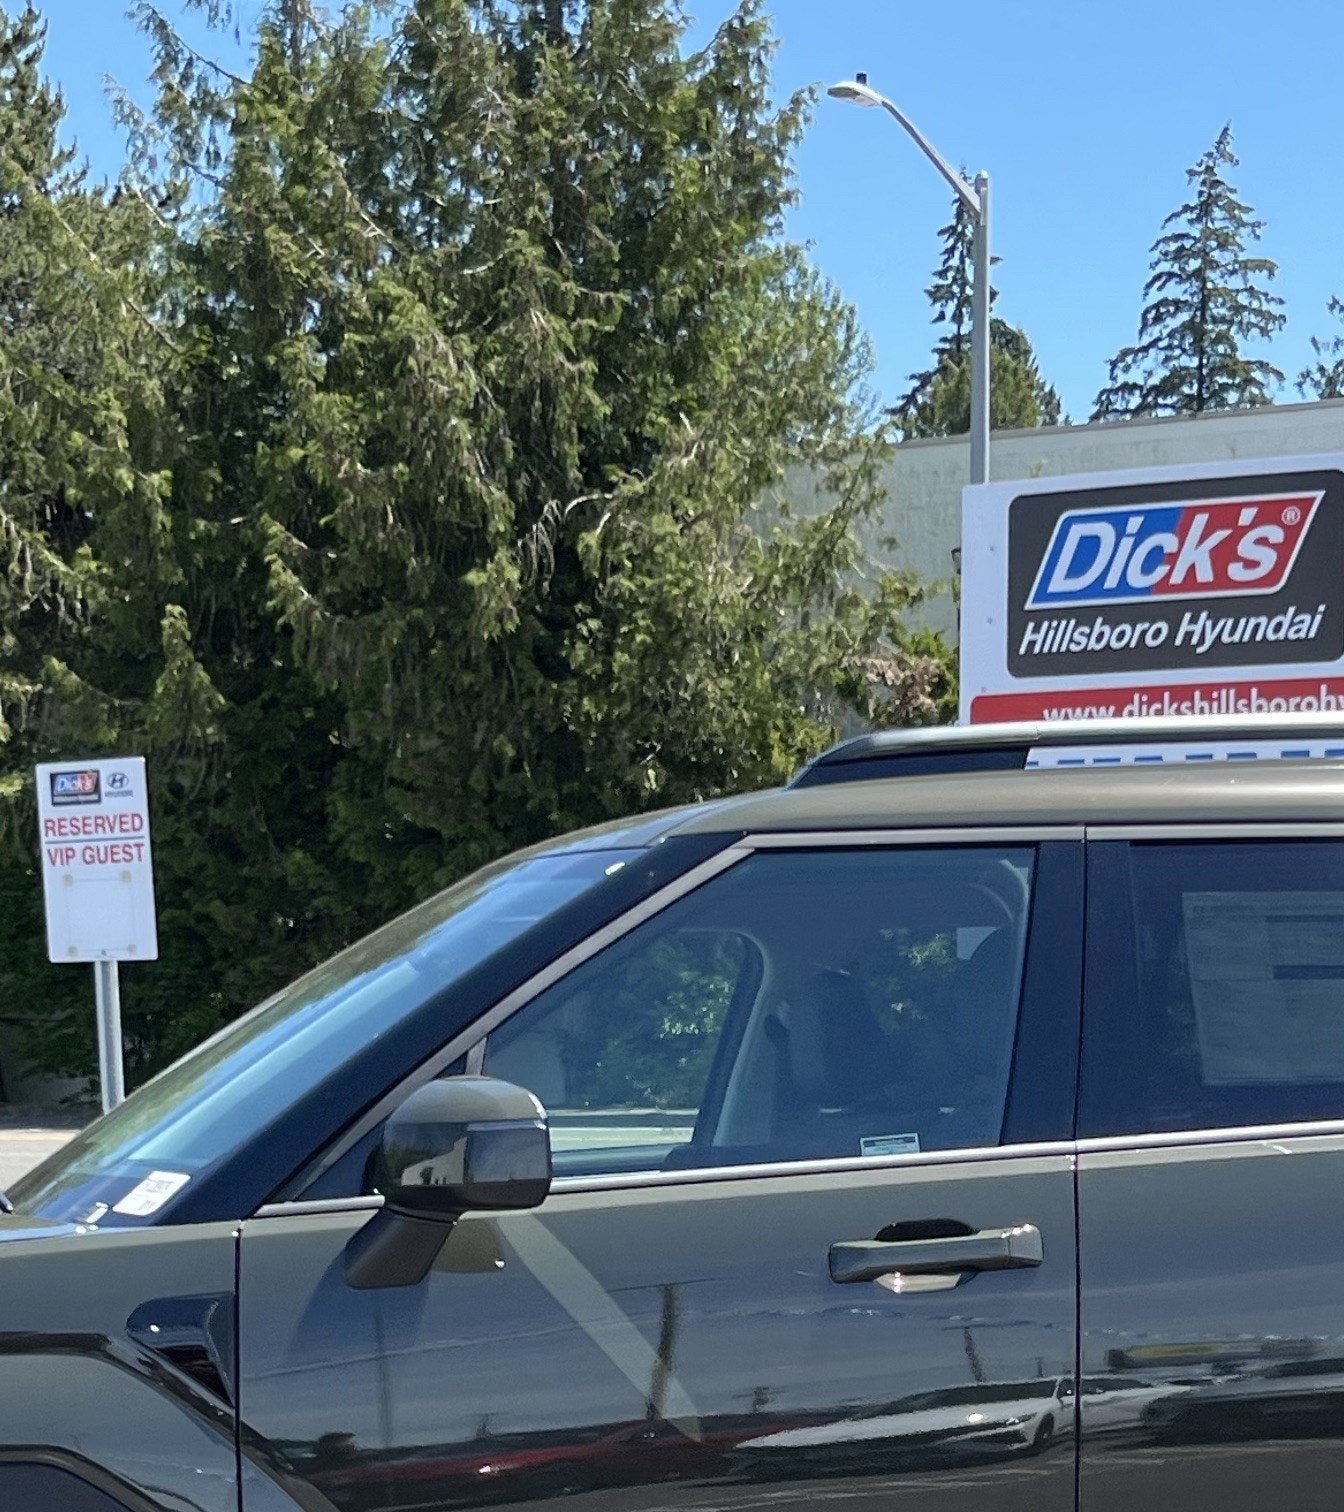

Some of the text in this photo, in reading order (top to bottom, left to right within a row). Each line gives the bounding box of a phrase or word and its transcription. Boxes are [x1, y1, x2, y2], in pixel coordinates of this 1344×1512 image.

[1018, 604, 1327, 655] Hillsboro Hyundai
[44, 813, 144, 837] RESERVED
[47, 843, 145, 867] VIP GUEST
